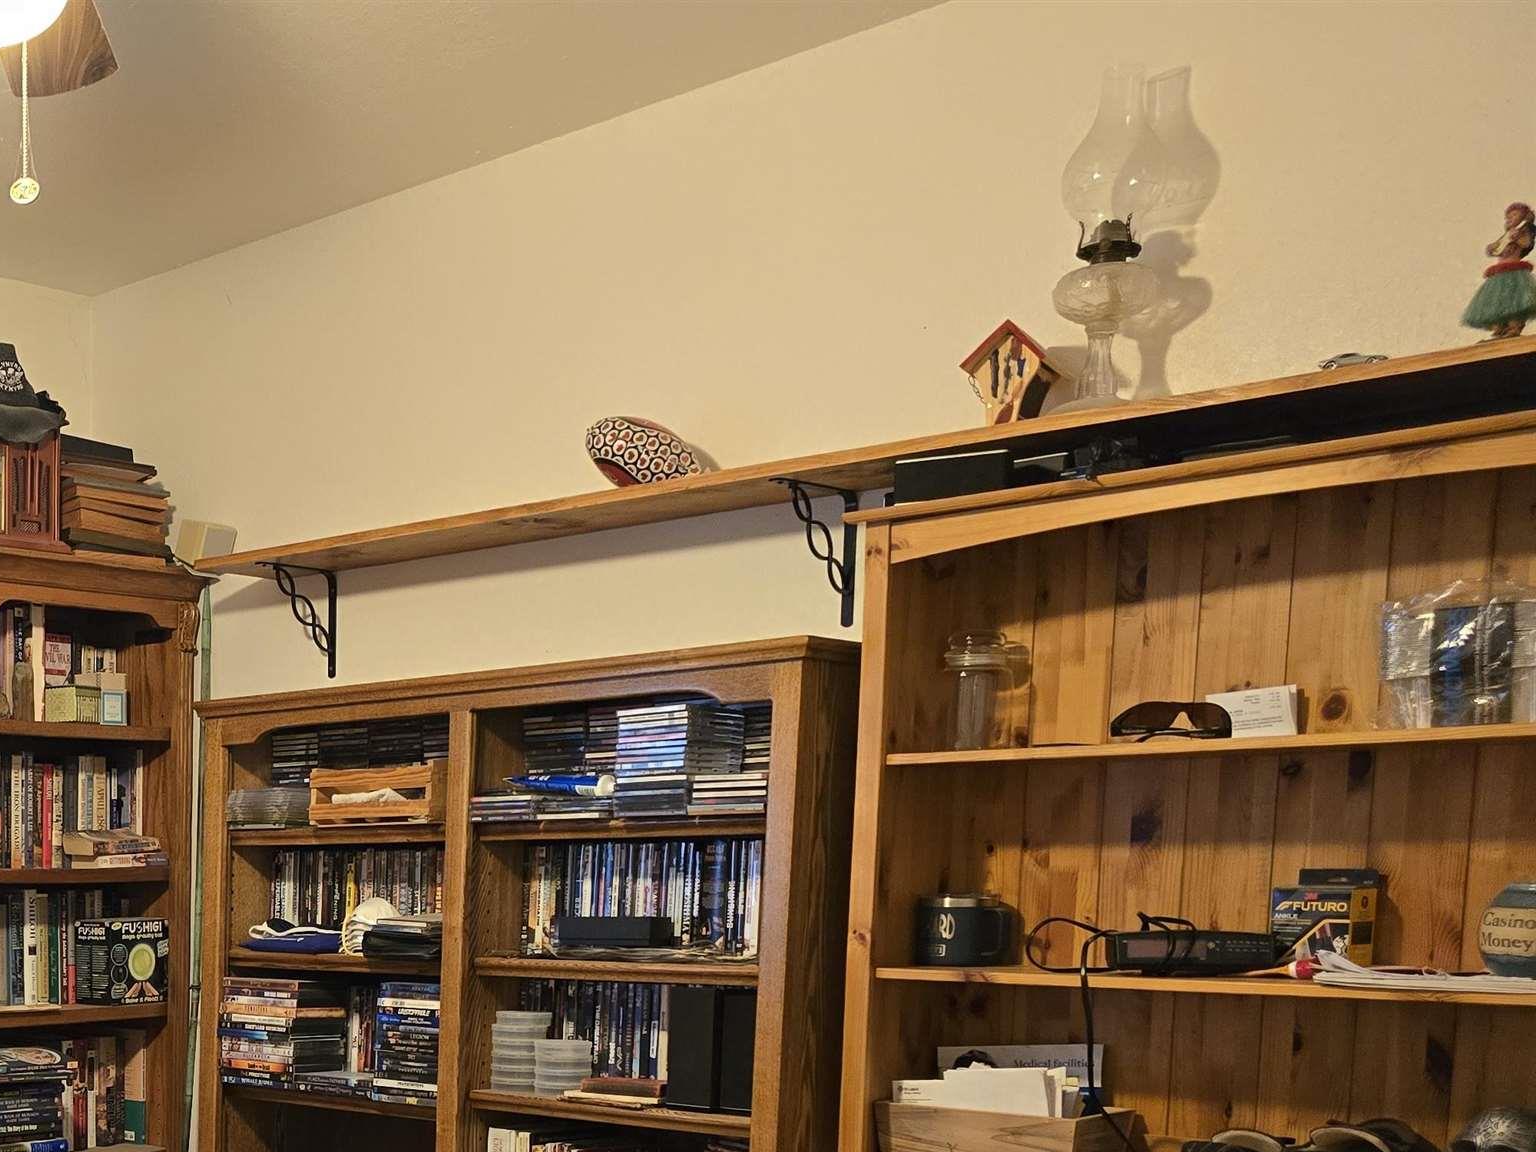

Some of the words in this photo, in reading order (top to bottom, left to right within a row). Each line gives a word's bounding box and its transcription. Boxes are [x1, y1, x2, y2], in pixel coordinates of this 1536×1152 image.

[97, 786, 106, 813] APRIL
[1304, 892, 1318, 901] 3M
[1293, 901, 1348, 912] FUTURO
[1483, 912, 1536, 929] Casino
[78, 927, 105, 936] FUSHIGI
[122, 921, 162, 933] FUSHIGI
[1481, 932, 1534, 952] Money
[1013, 1059, 1051, 1068] Medical
